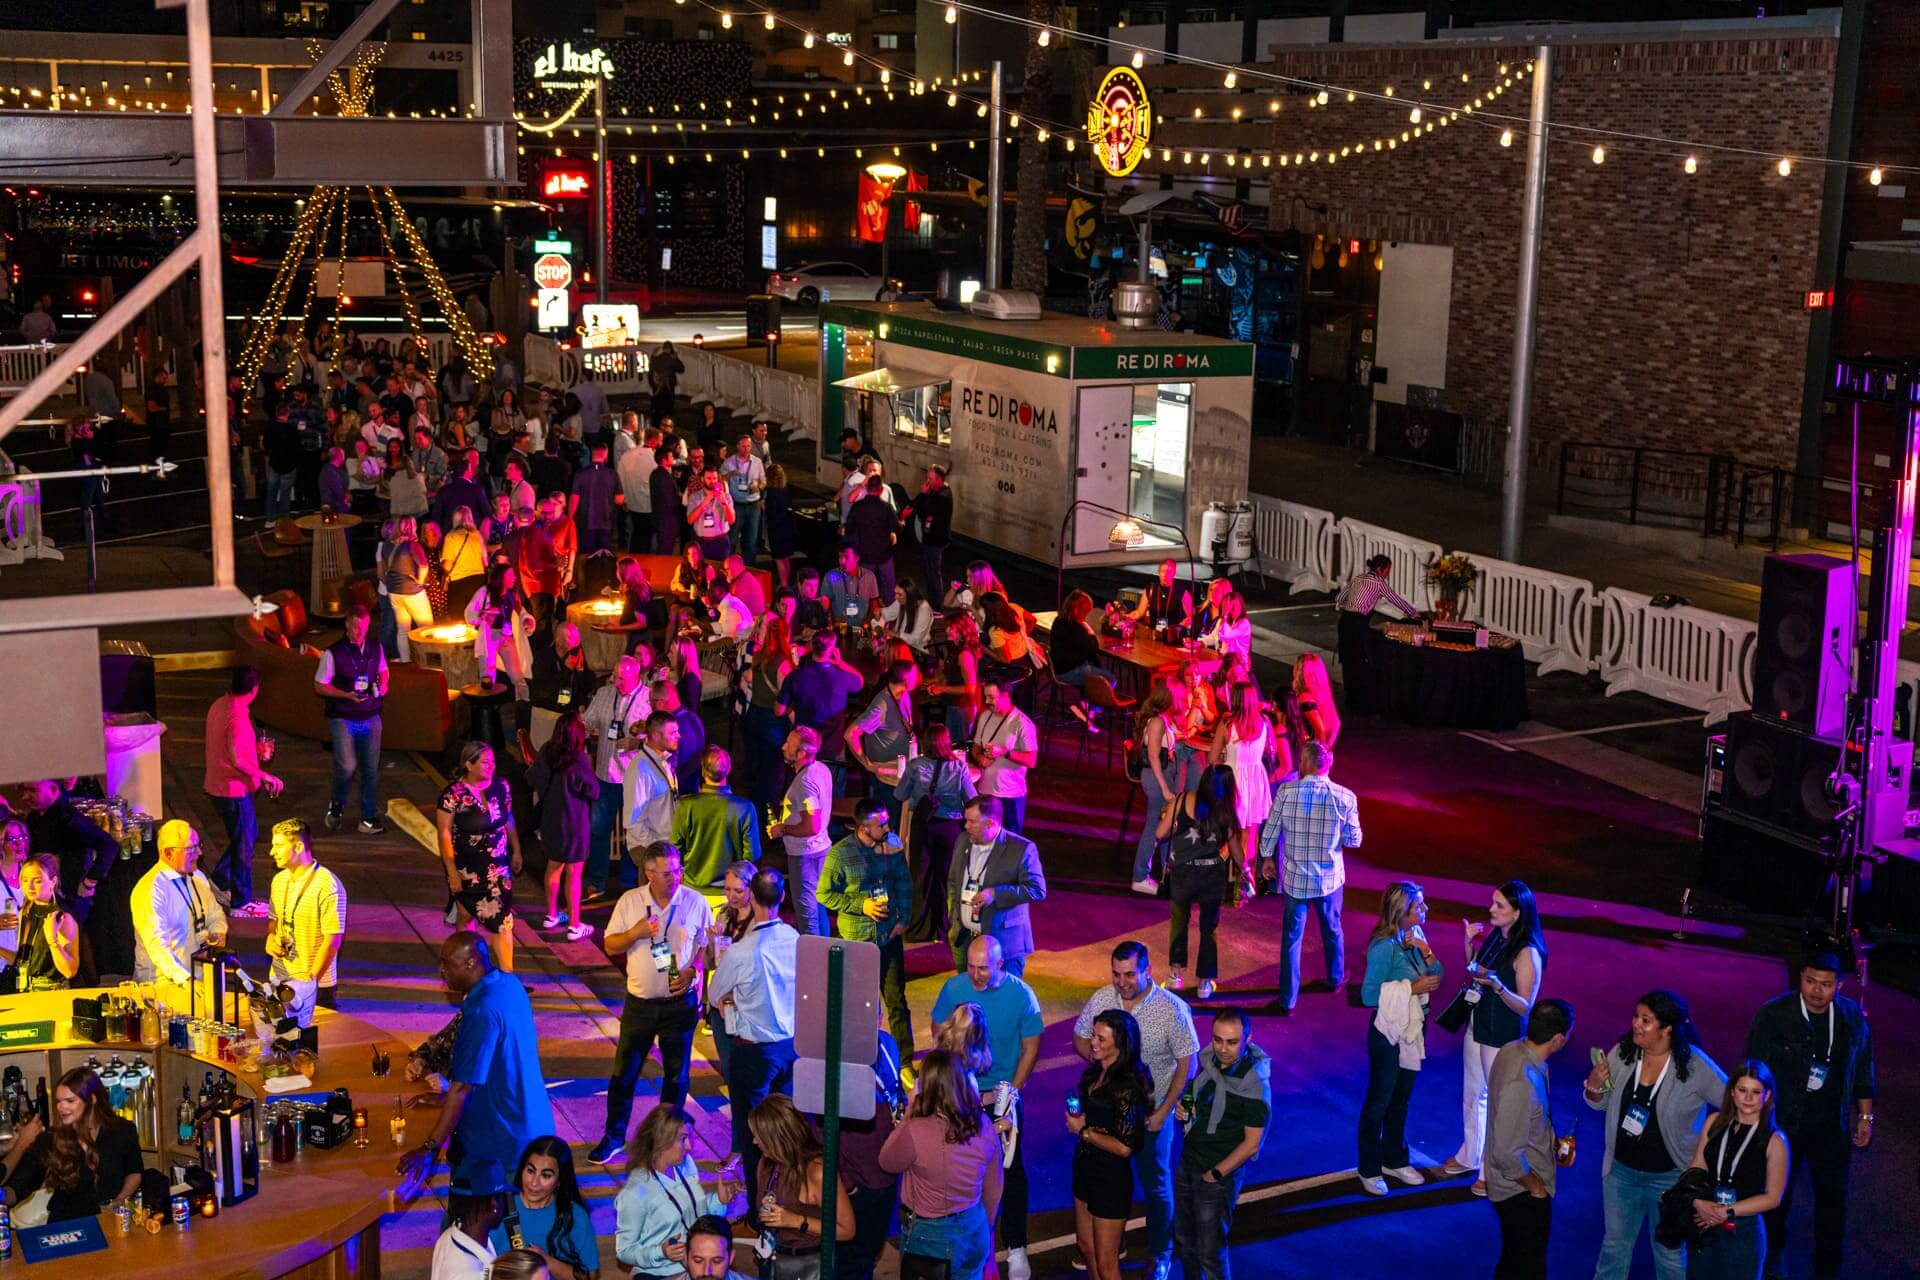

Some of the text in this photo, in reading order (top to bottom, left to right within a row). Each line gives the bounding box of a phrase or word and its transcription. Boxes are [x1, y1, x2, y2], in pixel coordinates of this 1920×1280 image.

[428, 50, 464, 62] 4425
[534, 44, 558, 78] el
[538, 265, 569, 281] STOP
[1809, 292, 1824, 307] EXIT
[962, 339, 984, 350] SALAD
[992, 345, 1014, 356] FRESH
[1017, 350, 1040, 361] PASTA
[1117, 354, 1139, 369] RE
[1143, 354, 1159, 369] DI
[962, 387, 983, 415] RE
[988, 393, 1004, 420] DI
